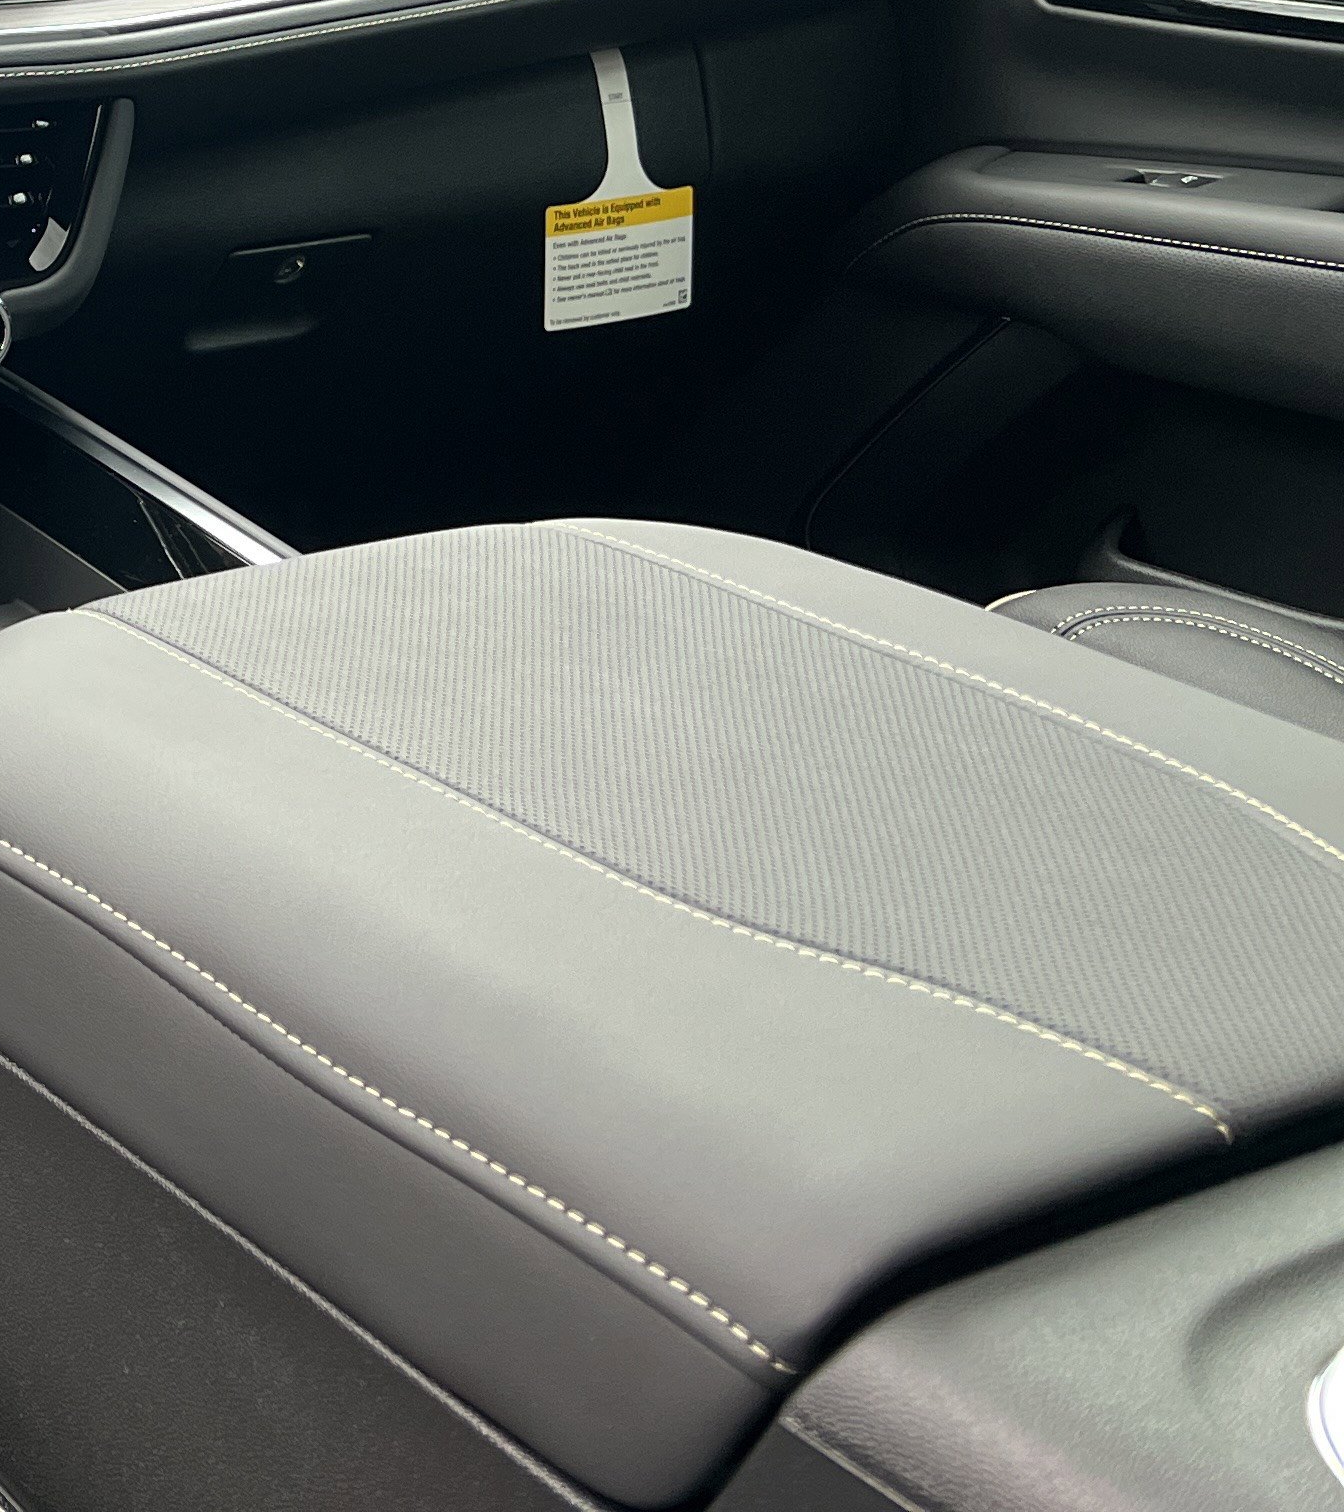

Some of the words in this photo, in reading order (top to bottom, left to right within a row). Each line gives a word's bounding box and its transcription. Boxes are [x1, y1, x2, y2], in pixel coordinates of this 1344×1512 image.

[554, 210, 571, 220] This
[573, 207, 601, 219] Vehicle
[602, 204, 609, 215] is
[611, 199, 644, 213] Equipped
[645, 197, 661, 207] with
[554, 219, 592, 232] Advanced
[594, 217, 605, 227] Air
[606, 215, 625, 226] Bags
